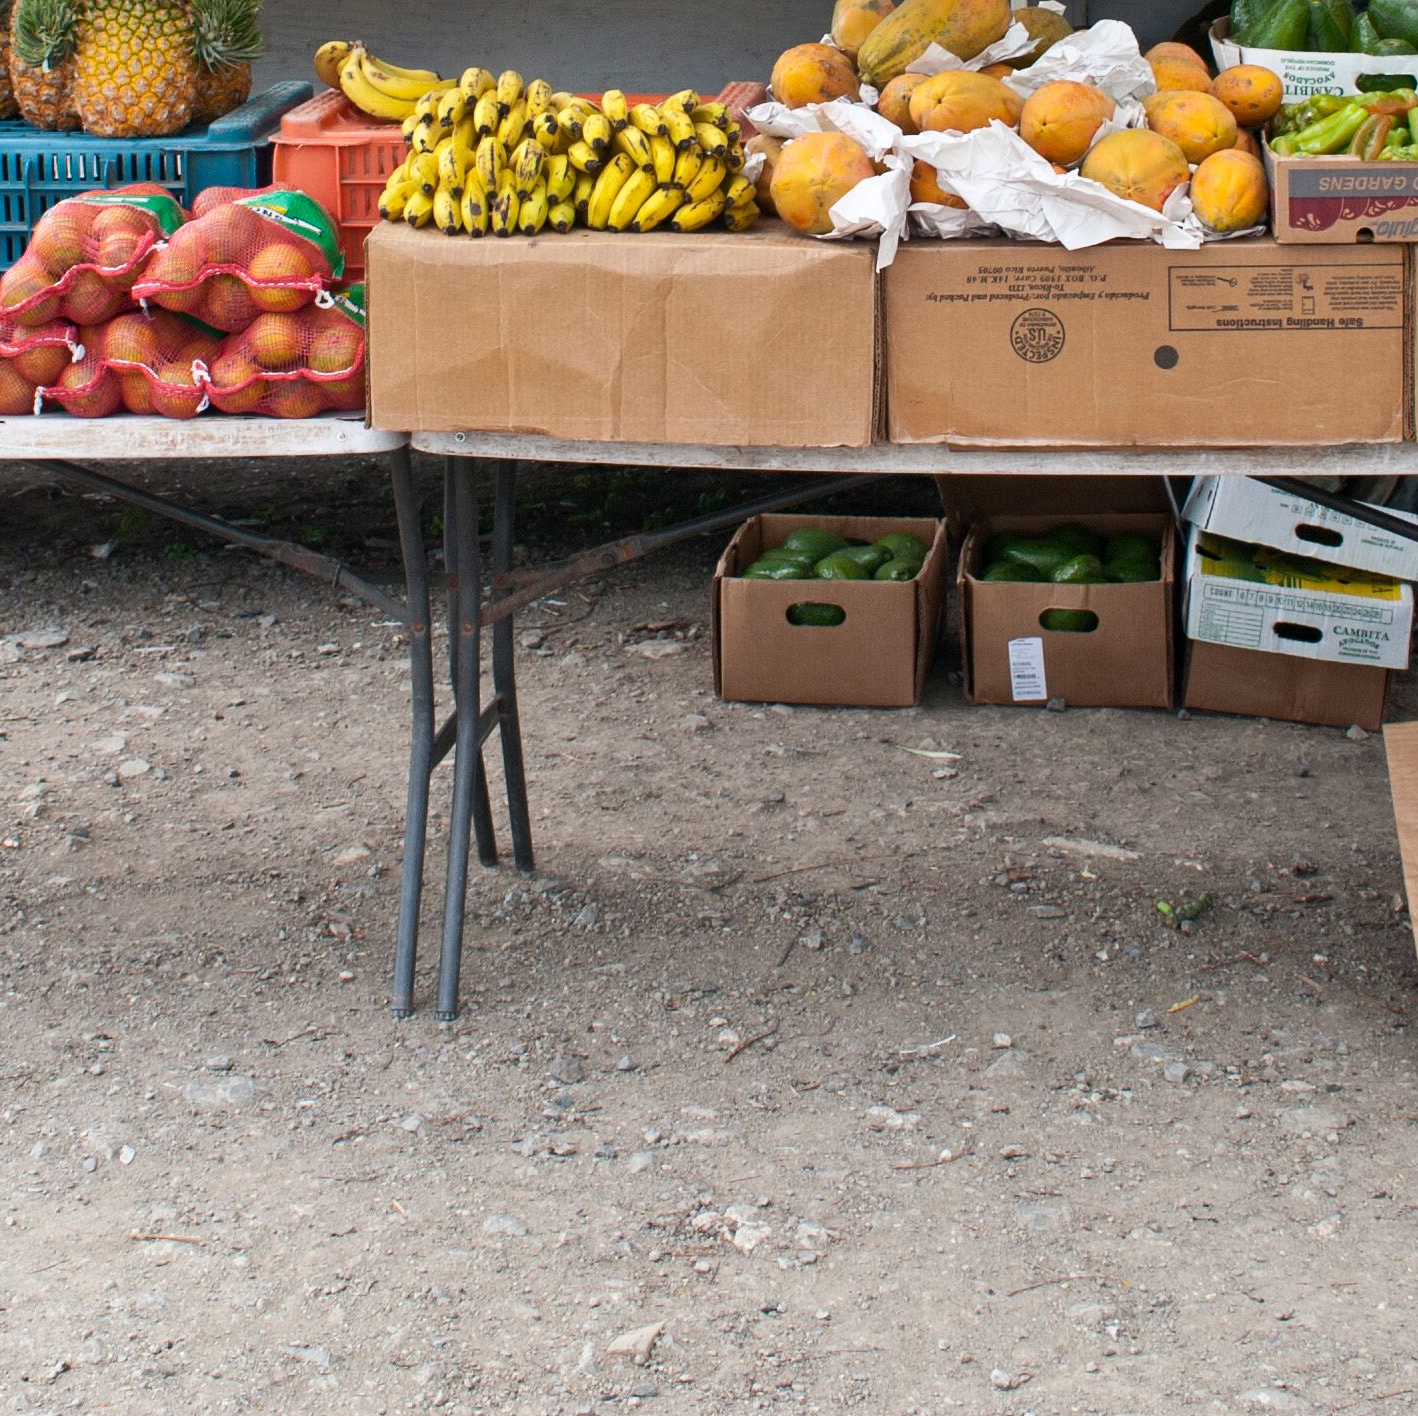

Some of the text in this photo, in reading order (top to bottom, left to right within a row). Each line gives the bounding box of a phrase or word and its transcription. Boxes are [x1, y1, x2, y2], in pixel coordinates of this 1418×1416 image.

[1284, 72, 1335, 85] AVOCADOS
[1284, 85, 1344, 97] CAMBIT
[1318, 175, 1407, 191] GARDENS
[1005, 266, 1024, 274] Rico
[1065, 274, 1085, 282] BOX
[939, 294, 970, 302] Packed
[971, 294, 987, 302] and
[1216, 317, 1364, 329] Safe Handling Instructions
[1014, 336, 1061, 360] INSPECTED
[1210, 587, 1233, 597] COUNT
[1333, 625, 1390, 641] CAMBITA
